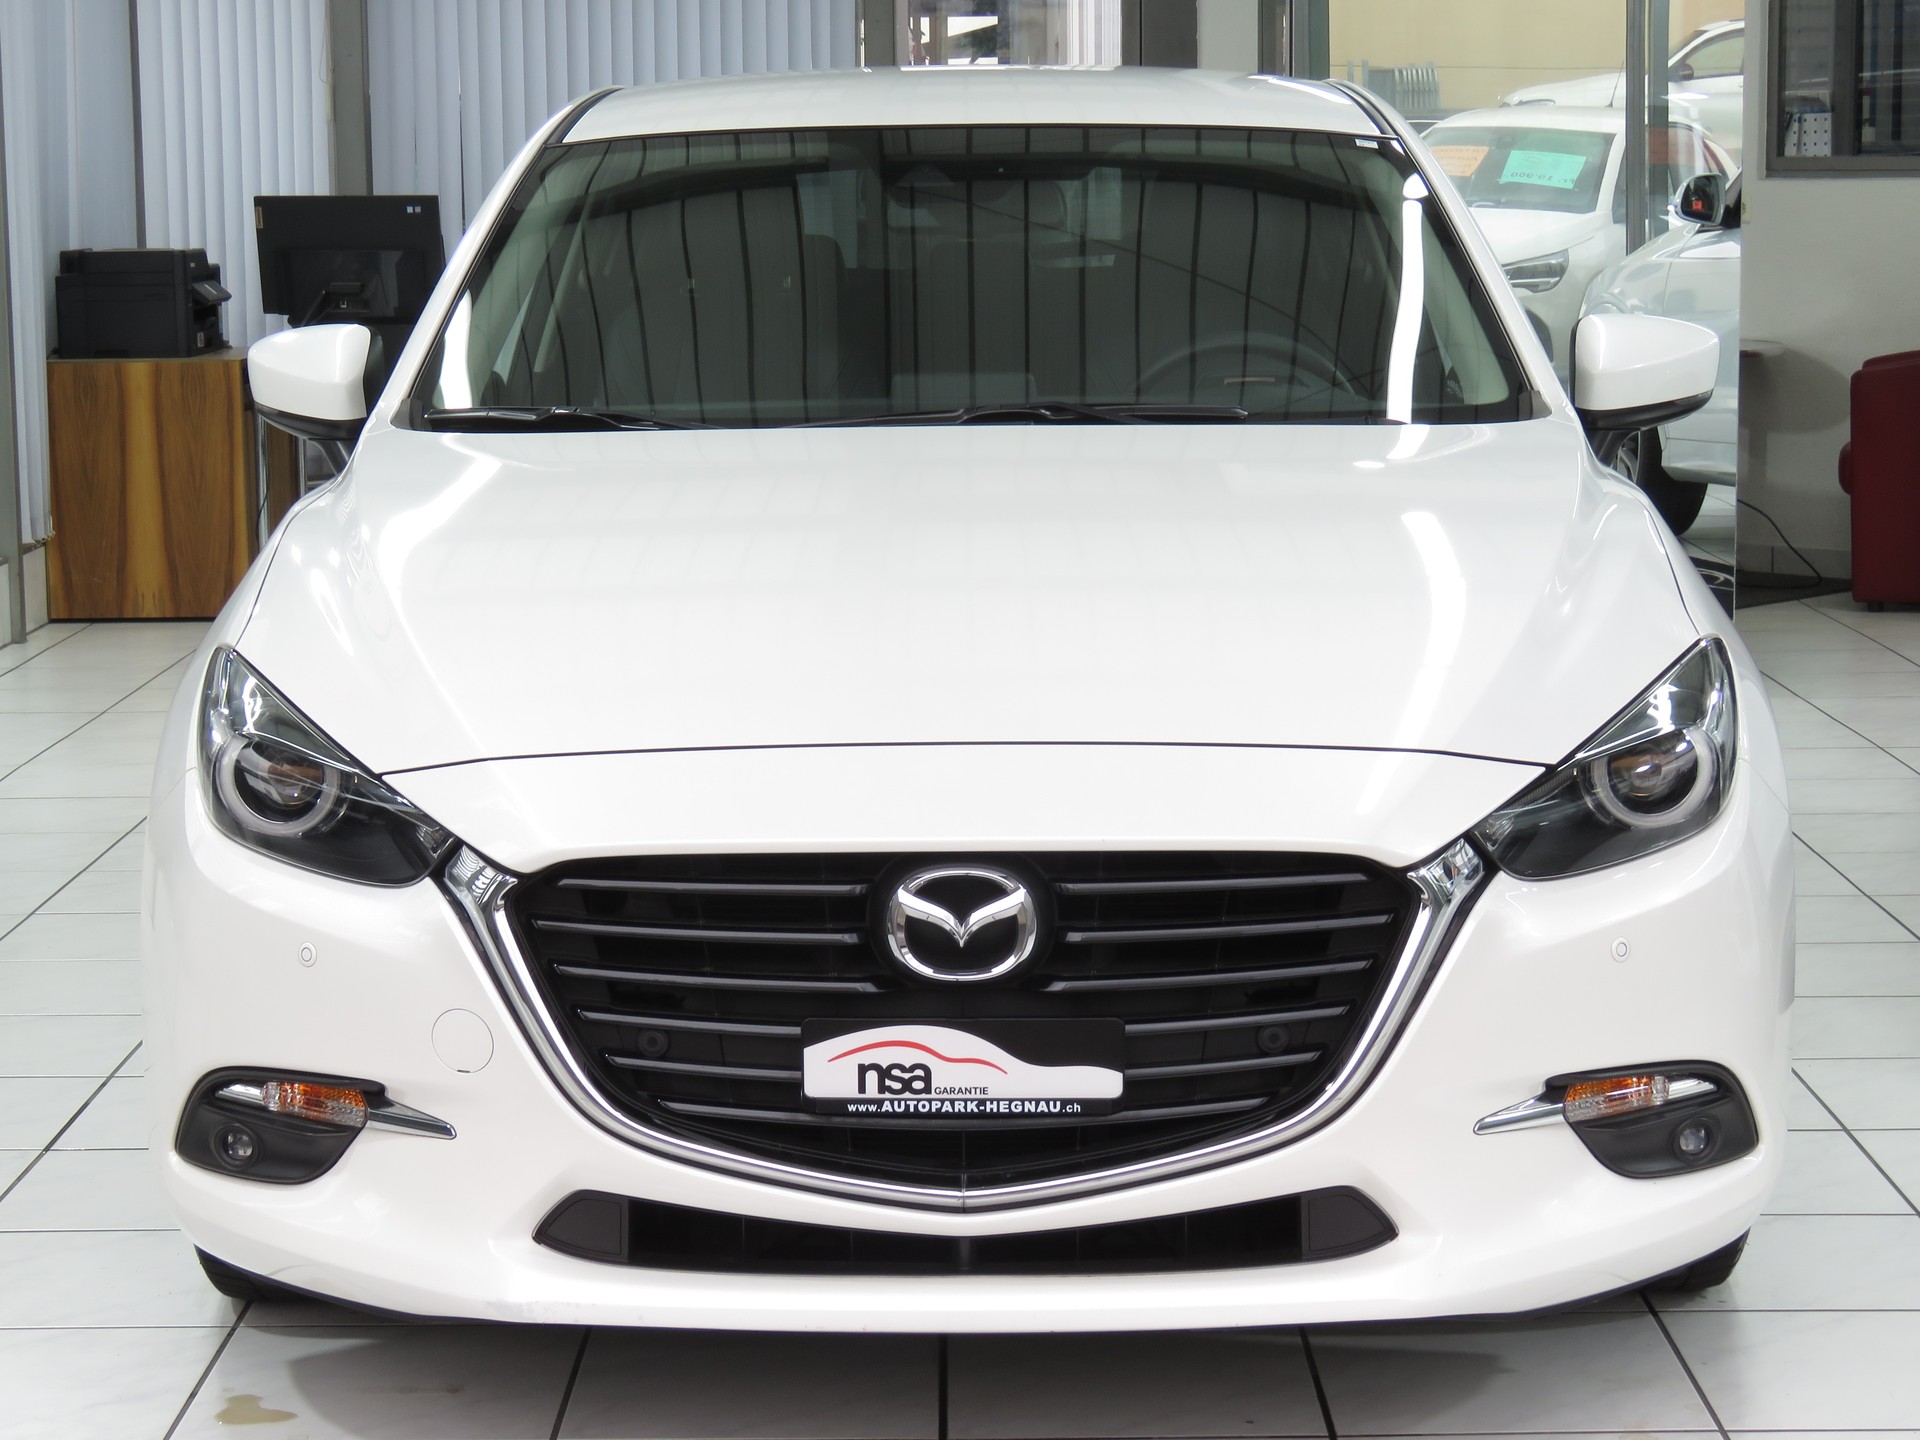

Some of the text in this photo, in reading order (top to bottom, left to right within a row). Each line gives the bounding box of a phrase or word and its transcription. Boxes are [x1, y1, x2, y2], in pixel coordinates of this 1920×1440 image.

[857, 1063, 989, 1095] nsa GARANTIE
[847, 1101, 1081, 1113] www.AUTOPARK-HEGNAU.ch
